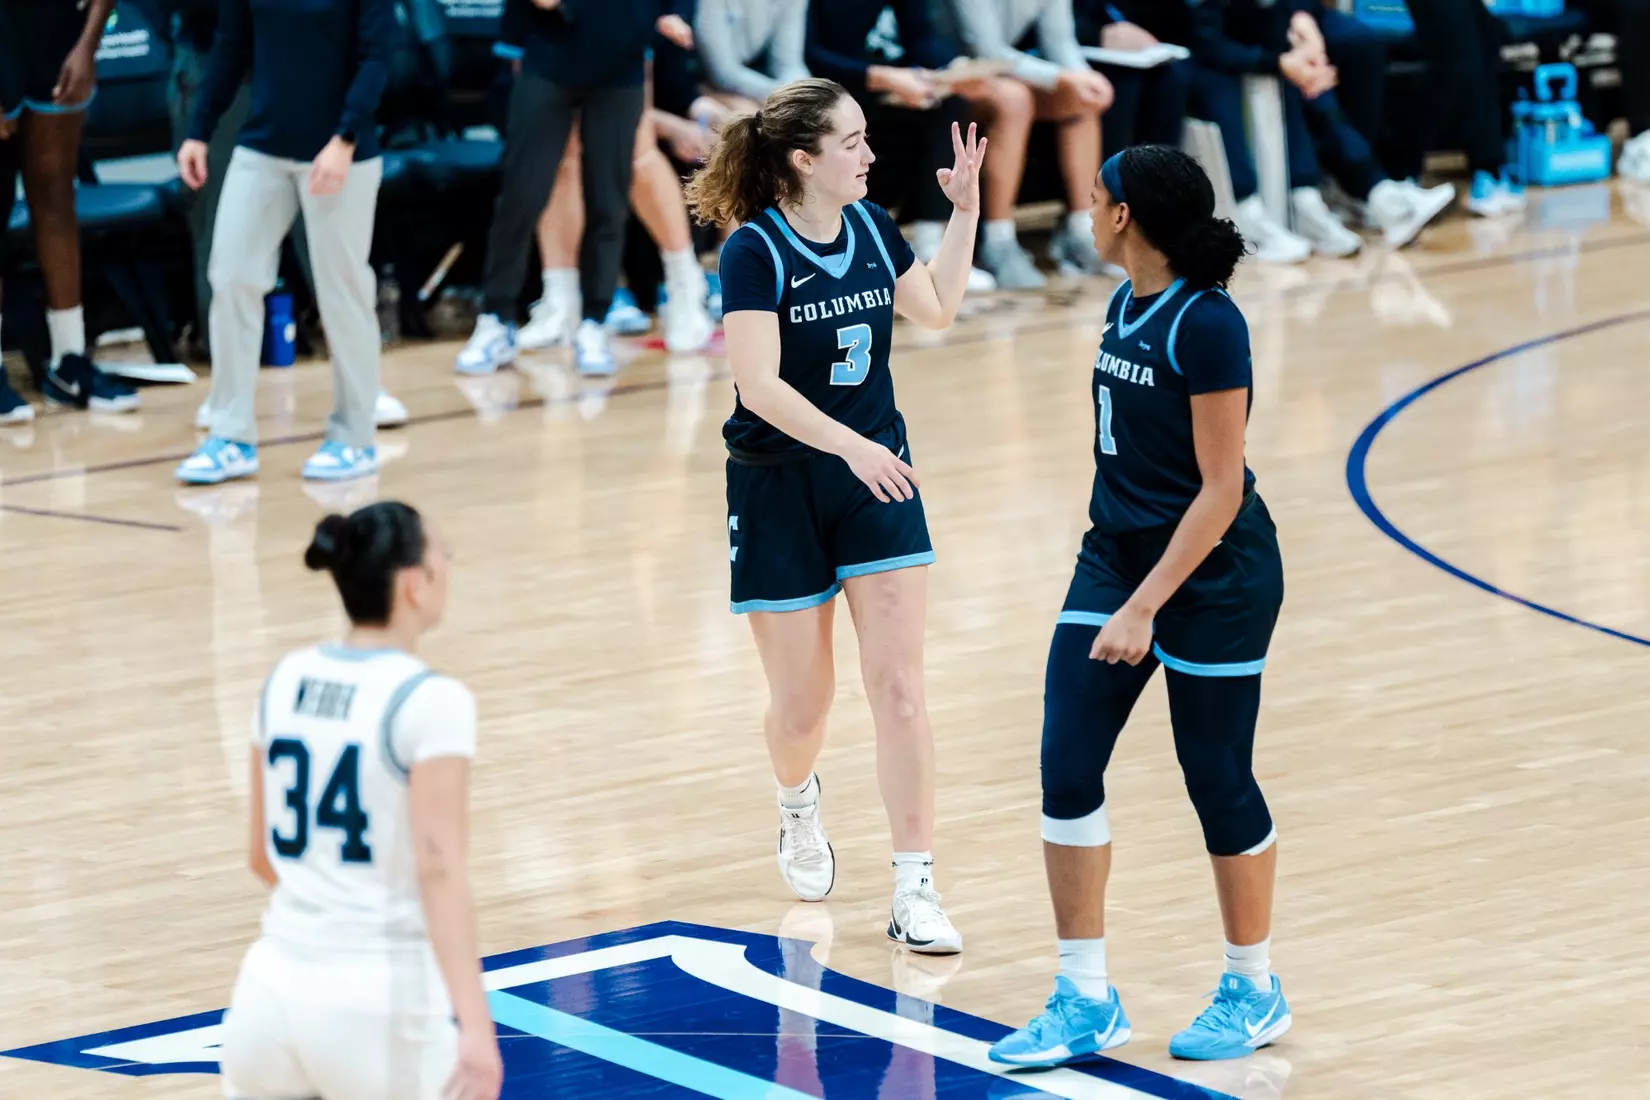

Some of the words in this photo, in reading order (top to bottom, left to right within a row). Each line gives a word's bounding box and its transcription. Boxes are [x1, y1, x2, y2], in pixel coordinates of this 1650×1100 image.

[789, 287, 892, 324] COLUMBIA
[829, 323, 873, 387] 3
[1094, 349, 1155, 387] LUMBIA
[1098, 384, 1118, 456] 1
[268, 738, 372, 862] 34
